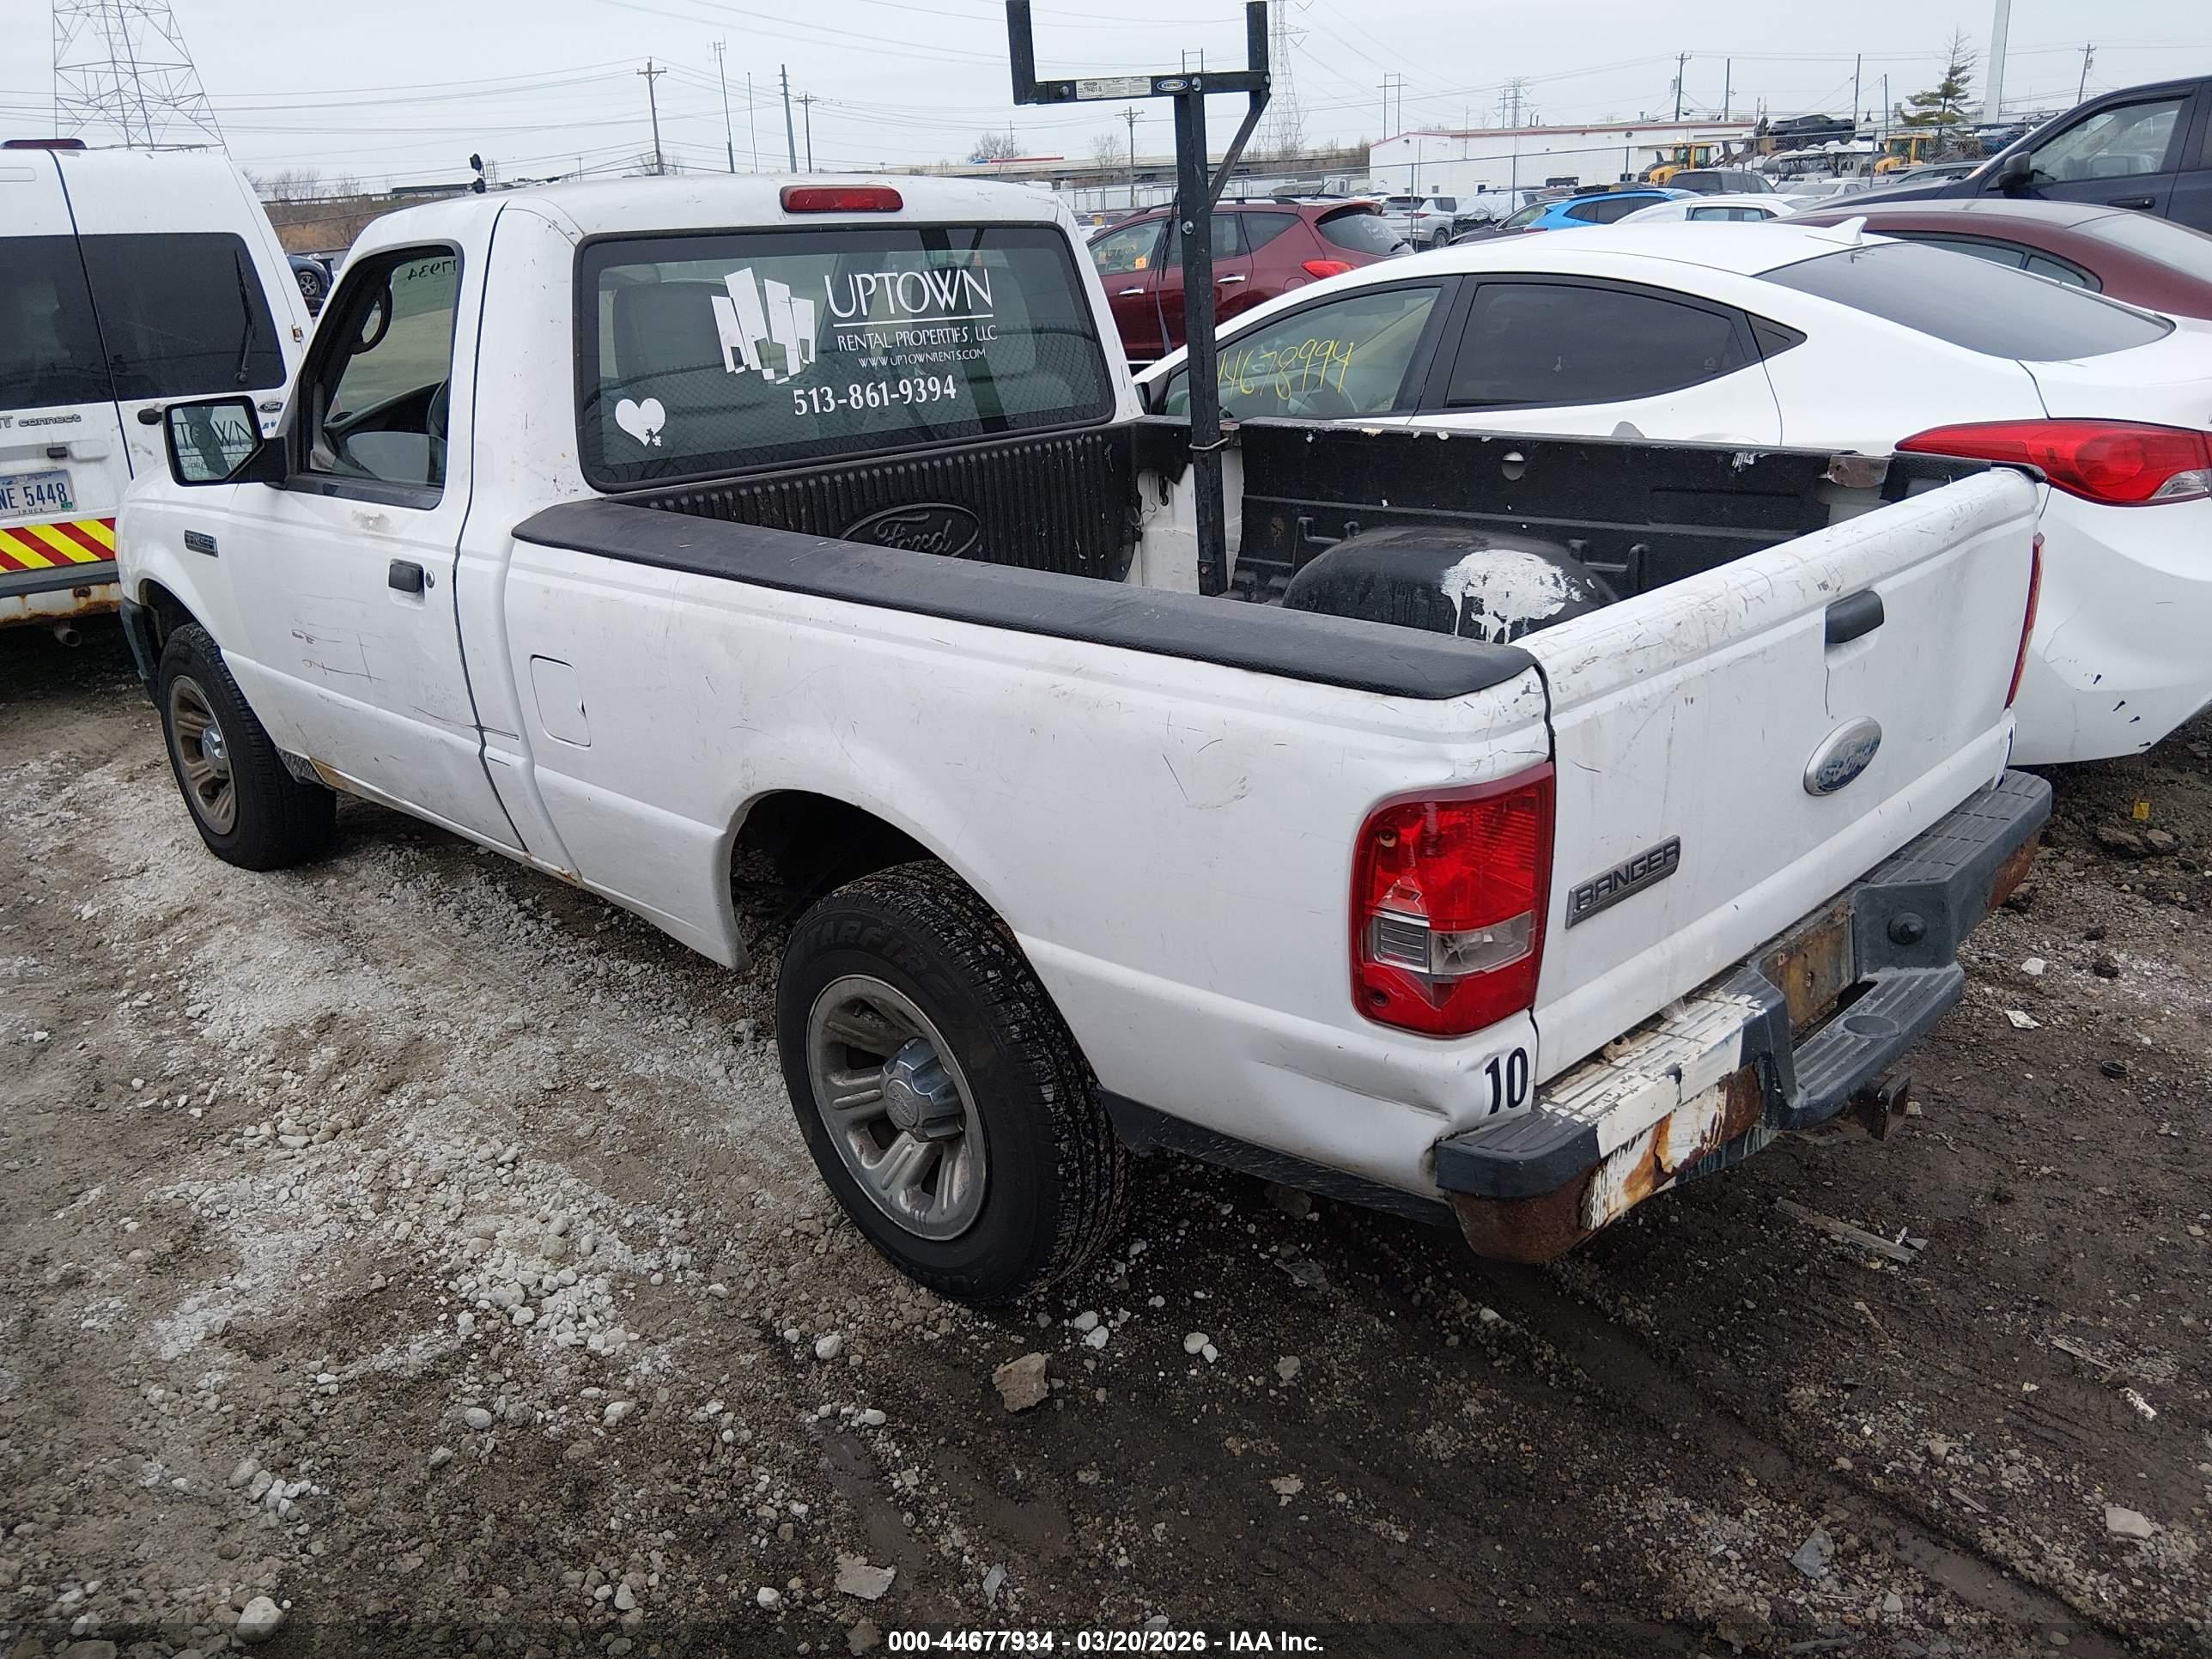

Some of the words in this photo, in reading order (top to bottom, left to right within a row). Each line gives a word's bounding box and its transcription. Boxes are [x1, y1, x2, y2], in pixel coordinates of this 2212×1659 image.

[824, 269, 993, 318] UPTOWN
[837, 332, 892, 352] RENTAL
[975, 325, 998, 342] LLC
[264, 402, 281, 410] Ford
[793, 374, 957, 416] 513-861-9394
[19, 413, 82, 428] connect
[23, 482, 68, 507] 5448
[1820, 732, 1879, 783] Ford
[1575, 840, 1680, 911] RANGER
[1485, 1047, 1528, 1115] 10
